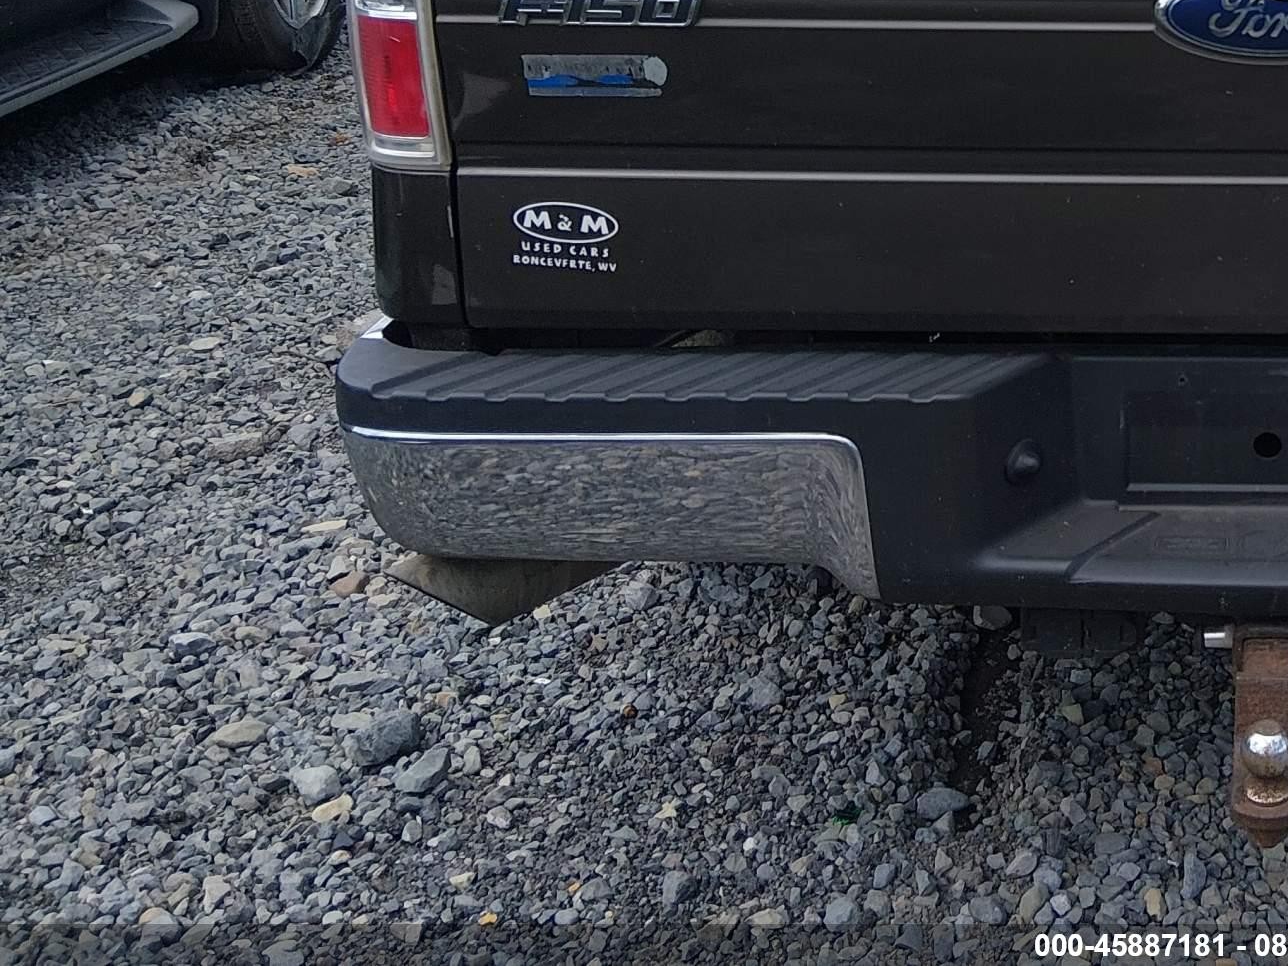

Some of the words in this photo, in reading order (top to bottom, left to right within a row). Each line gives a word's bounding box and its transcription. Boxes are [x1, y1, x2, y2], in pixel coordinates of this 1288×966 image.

[523, 209, 552, 230] M
[557, 214, 572, 231] &
[580, 215, 609, 235] M
[521, 241, 561, 253] USED
[569, 245, 609, 258] CARS
[597, 262, 616, 272] WV
